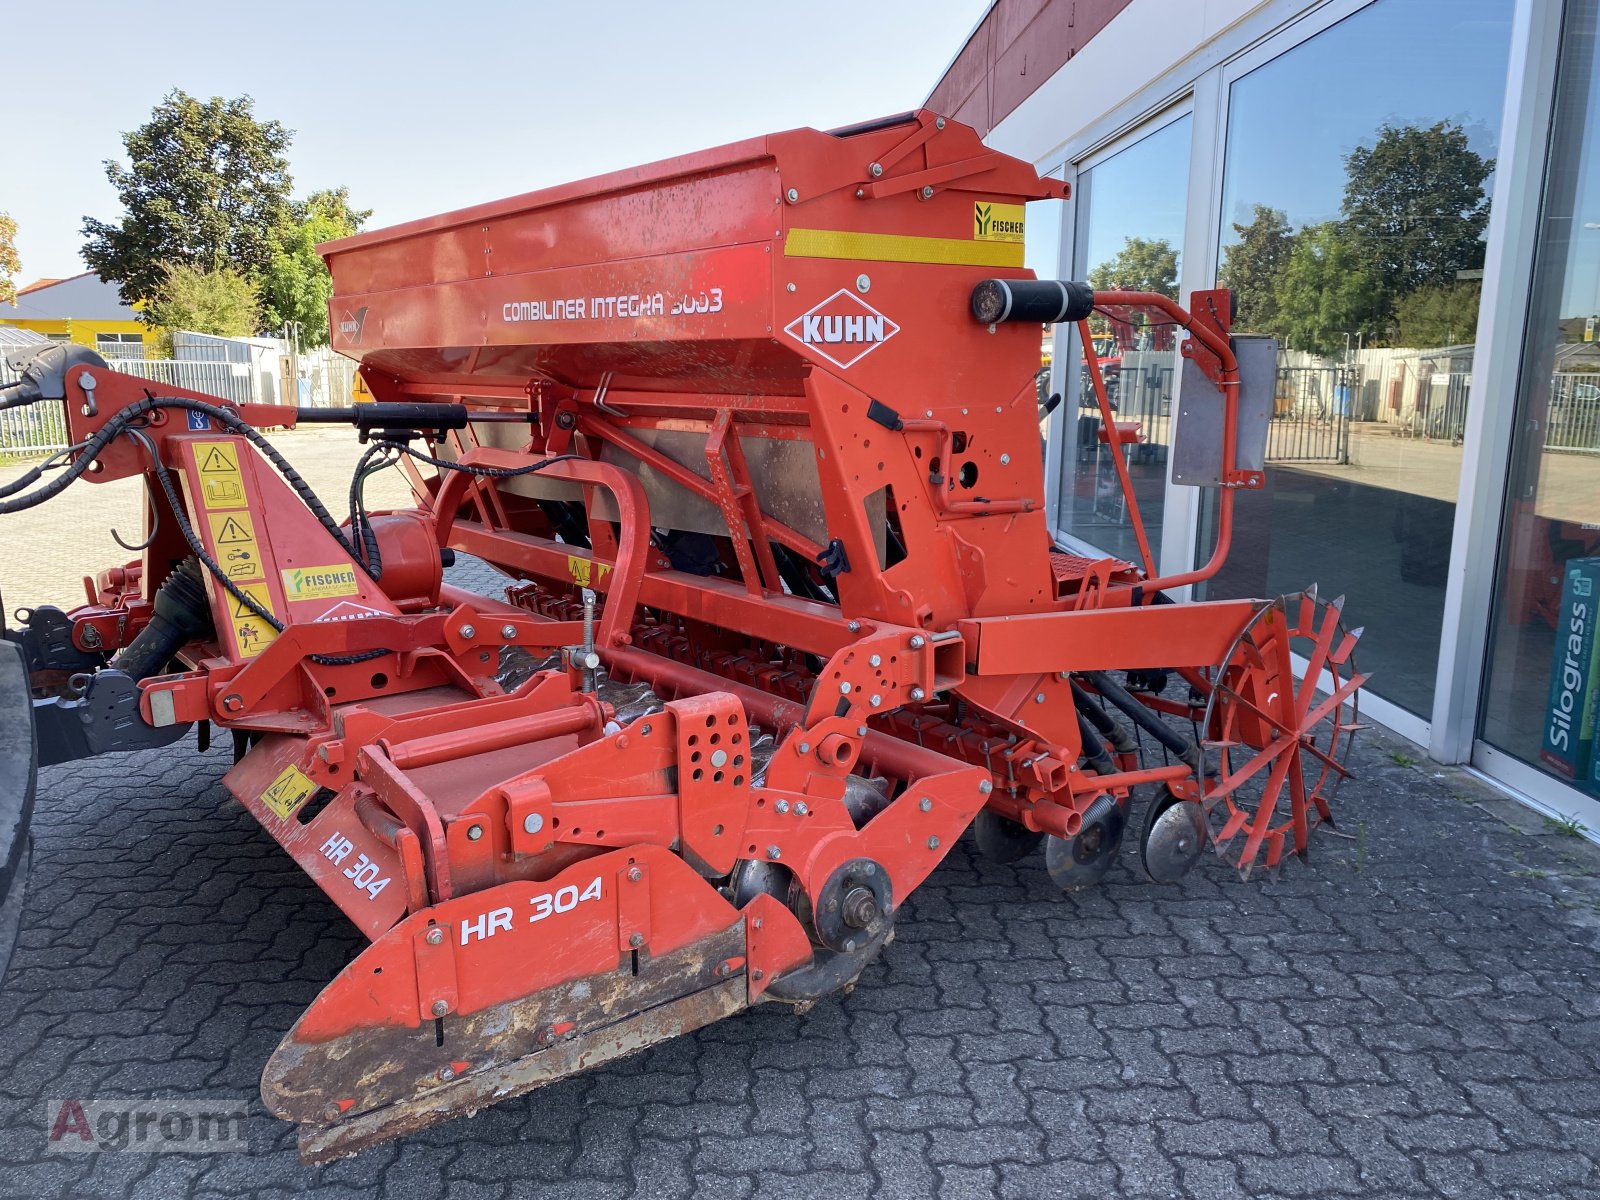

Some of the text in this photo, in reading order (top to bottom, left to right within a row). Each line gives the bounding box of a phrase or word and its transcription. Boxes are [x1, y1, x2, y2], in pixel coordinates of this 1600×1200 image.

[992, 220, 1024, 233] FISCHER
[502, 297, 586, 322] COMBILINER
[591, 293, 664, 319] INTEGRA
[803, 314, 884, 343] KUHN
[304, 571, 355, 587] FISCHER
[1549, 602, 1587, 752] Silograss
[319, 831, 391, 900] HR 304
[460, 876, 602, 946] HR 304
